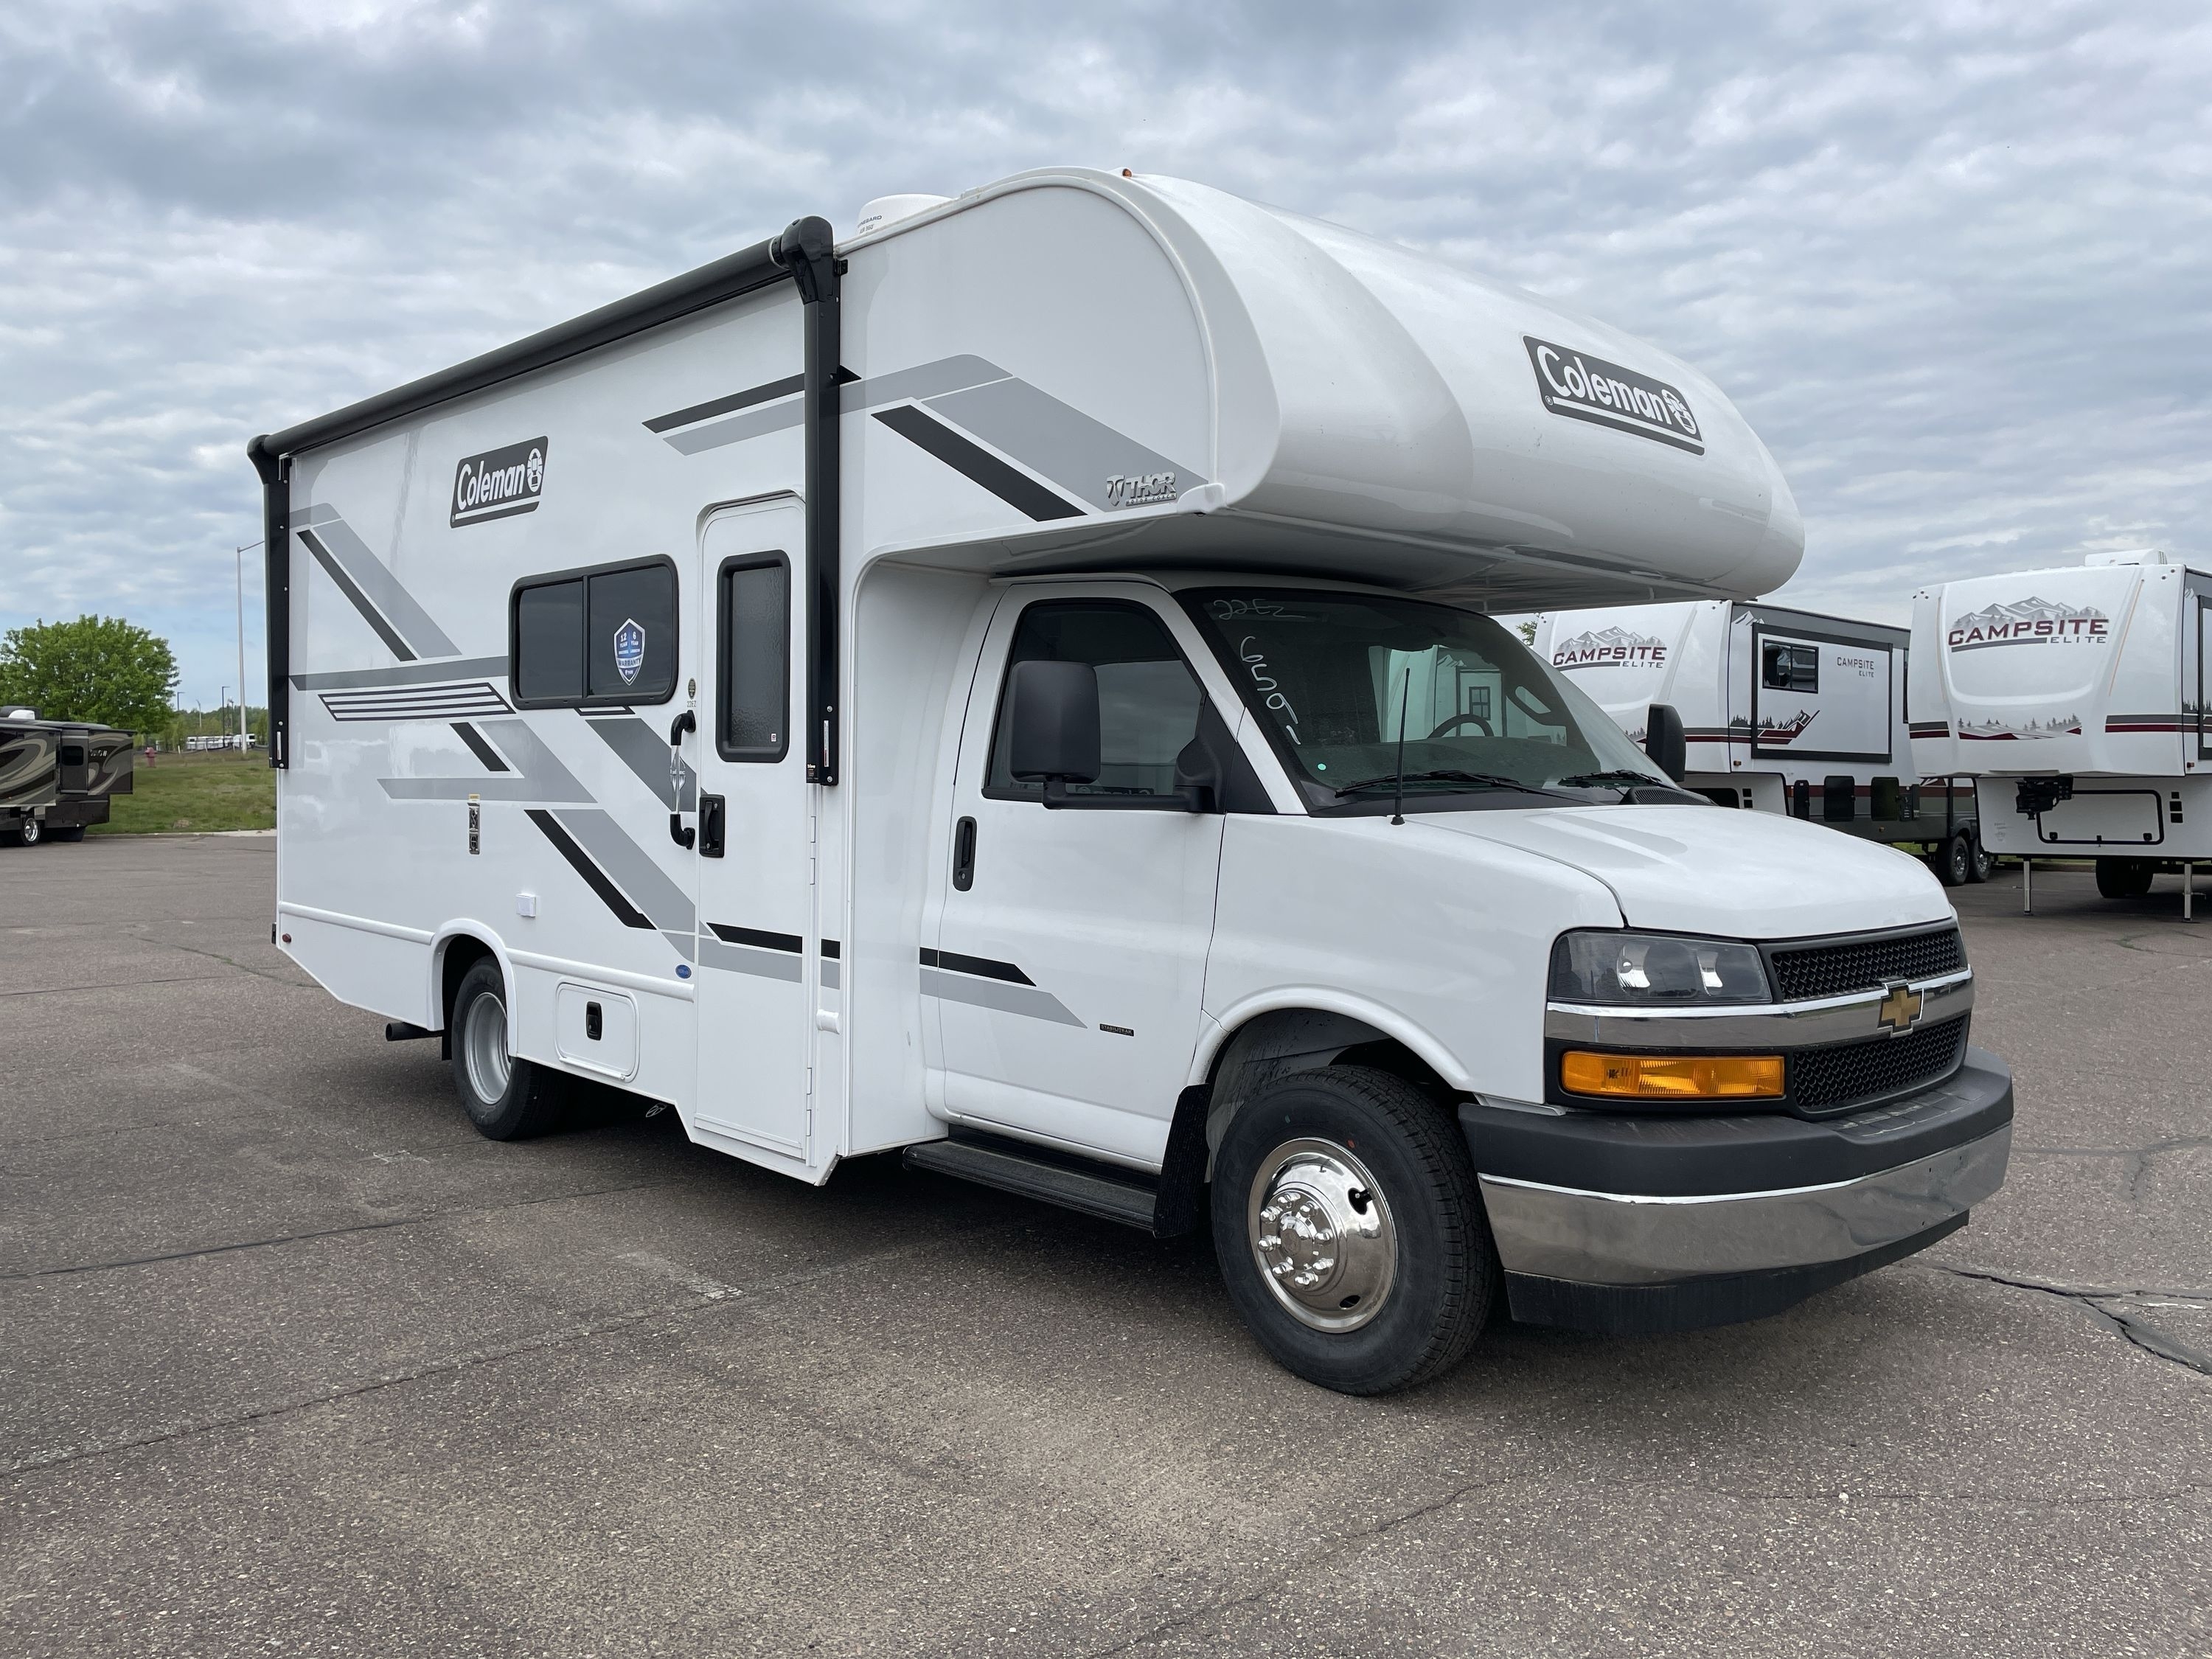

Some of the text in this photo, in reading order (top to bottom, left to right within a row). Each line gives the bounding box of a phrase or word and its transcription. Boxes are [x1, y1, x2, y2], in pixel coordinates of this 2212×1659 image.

[1537, 345, 1672, 425] Coleman
[457, 461, 525, 510] Coleman
[1126, 472, 1176, 498] THOR
[620, 633, 627, 642] 12
[633, 631, 636, 640] 6
[1947, 619, 2109, 646] CAMPSITE
[618, 657, 641, 667] WARRANTY
[1553, 647, 1667, 666] CAMPSITE
[1837, 657, 1874, 669] CAMPSITE
